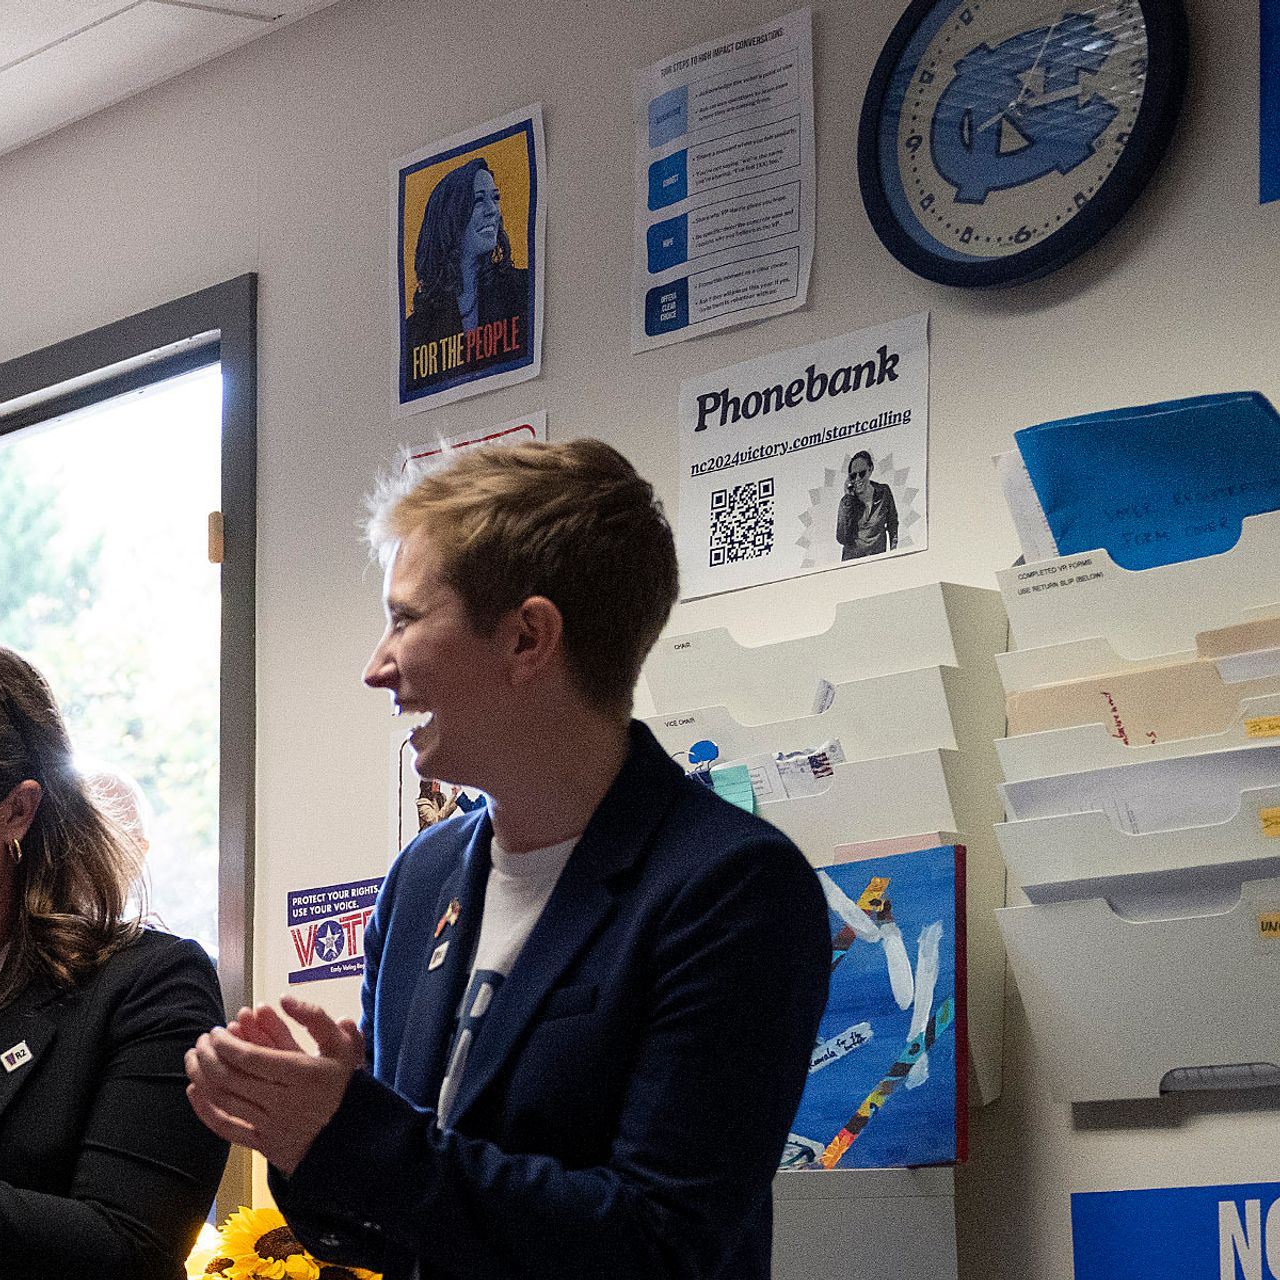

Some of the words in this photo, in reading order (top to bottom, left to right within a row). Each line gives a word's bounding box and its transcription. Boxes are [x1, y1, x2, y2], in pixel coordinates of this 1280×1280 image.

[906, 135, 923, 153] 9
[1015, 226, 1032, 244] 6
[413, 341, 438, 380] FOR
[440, 332, 464, 372] THE
[465, 316, 520, 363] PEOPLE
[694, 344, 900, 432] Phonebank
[690, 408, 912, 478] nc2024victory.com/startcalling
[292, 893, 326, 906] PROTECT
[327, 890, 349, 900] YOUR
[351, 885, 380, 896] RIGHTS.
[292, 908, 308, 918] USE
[310, 904, 332, 915] YOUR
[334, 900, 359, 911] VOICE.
